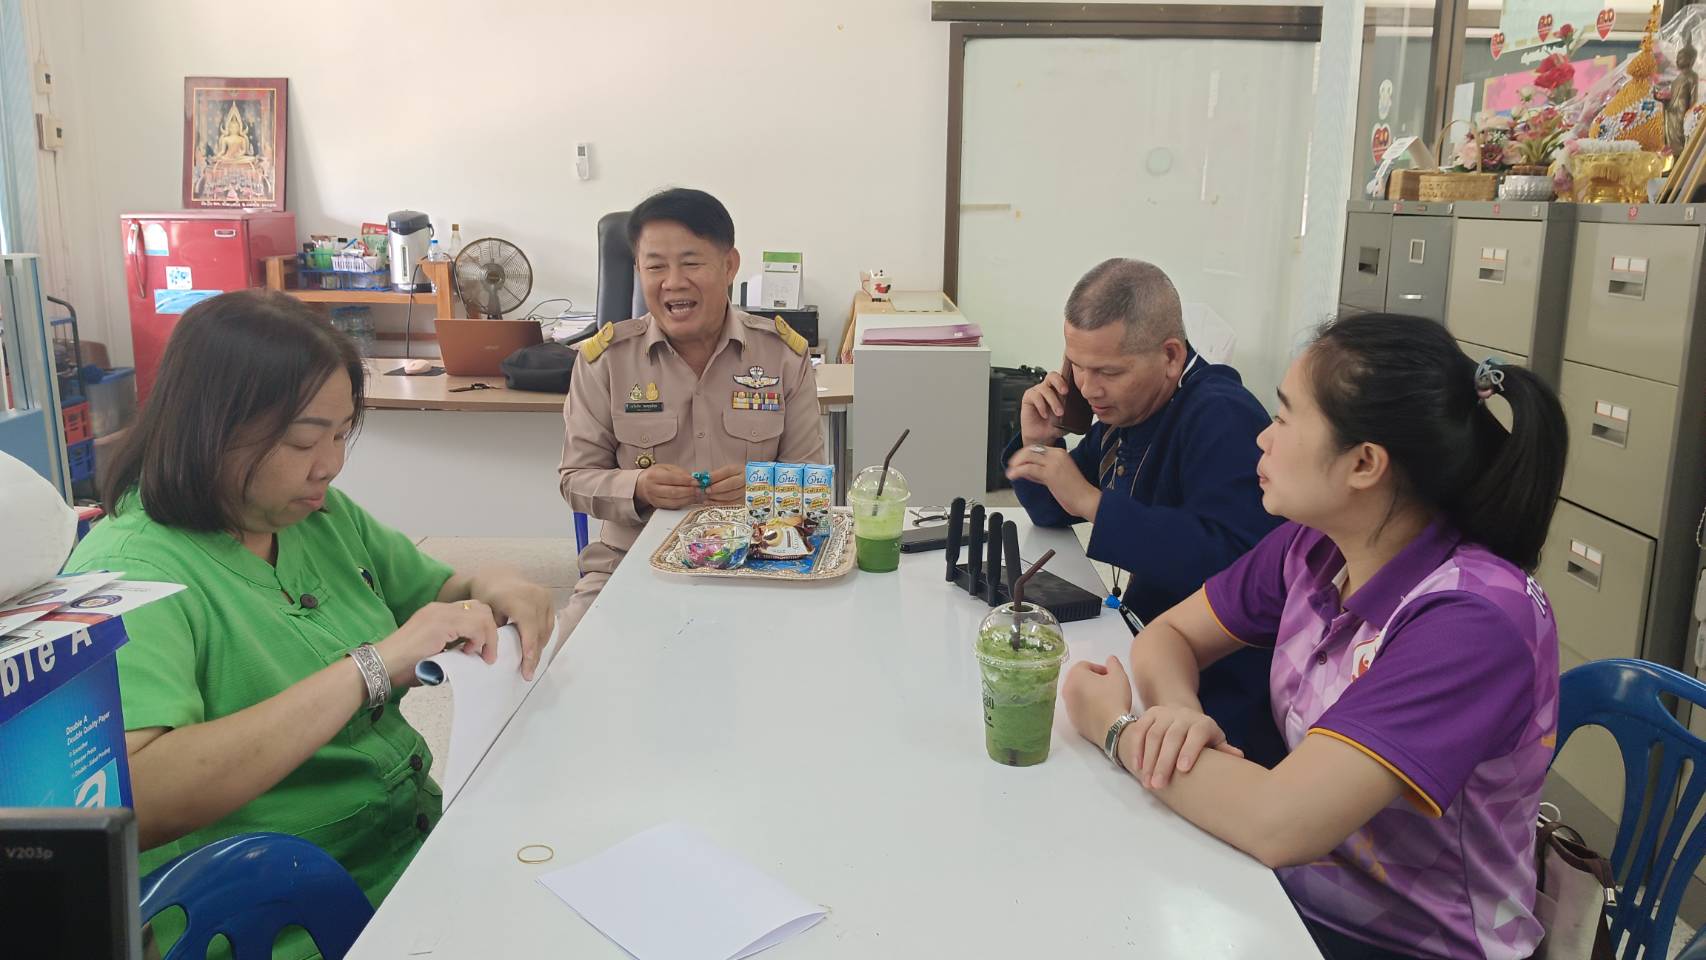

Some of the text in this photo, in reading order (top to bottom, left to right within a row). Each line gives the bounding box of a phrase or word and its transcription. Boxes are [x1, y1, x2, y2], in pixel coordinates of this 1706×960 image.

[66, 714, 88, 735] Double A
[67, 711, 111, 746] Double Quality Paper
[4, 847, 54, 862] V203p
